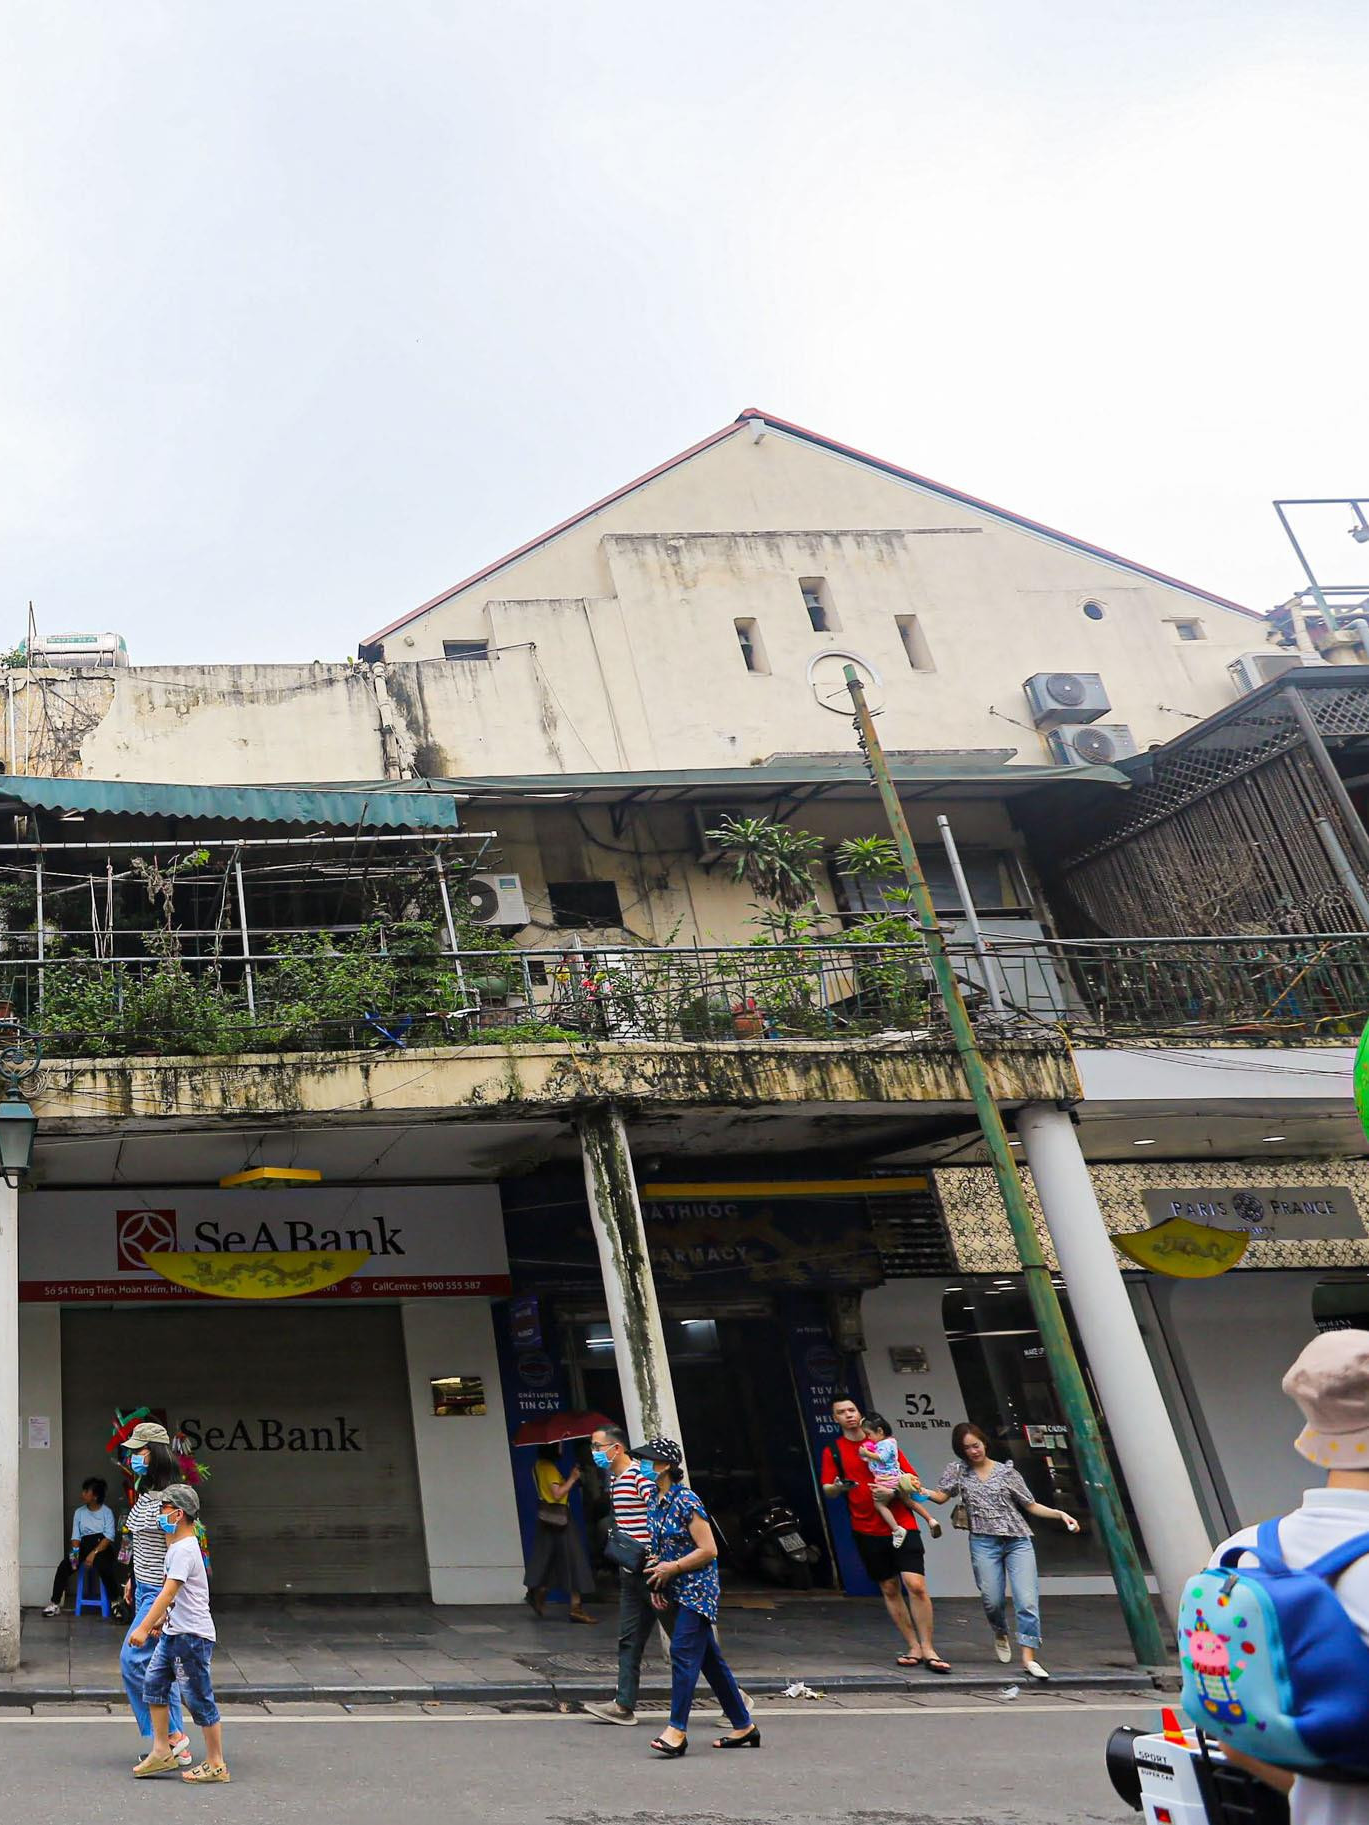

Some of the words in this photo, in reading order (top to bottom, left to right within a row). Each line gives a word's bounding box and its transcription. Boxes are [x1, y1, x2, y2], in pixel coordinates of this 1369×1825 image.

[1171, 1201, 1228, 1217] PARIS
[1271, 1200, 1338, 1215] FRANCE
[194, 1216, 406, 1256] SeABank
[57, 1286, 68, 1295] 54
[372, 1281, 420, 1292] CallCentre:
[422, 1281, 444, 1291] 1900
[445, 1280, 463, 1290] 555
[464, 1279, 481, 1289] 587
[905, 1394, 935, 1415] 52
[181, 1416, 363, 1451] SeABank
